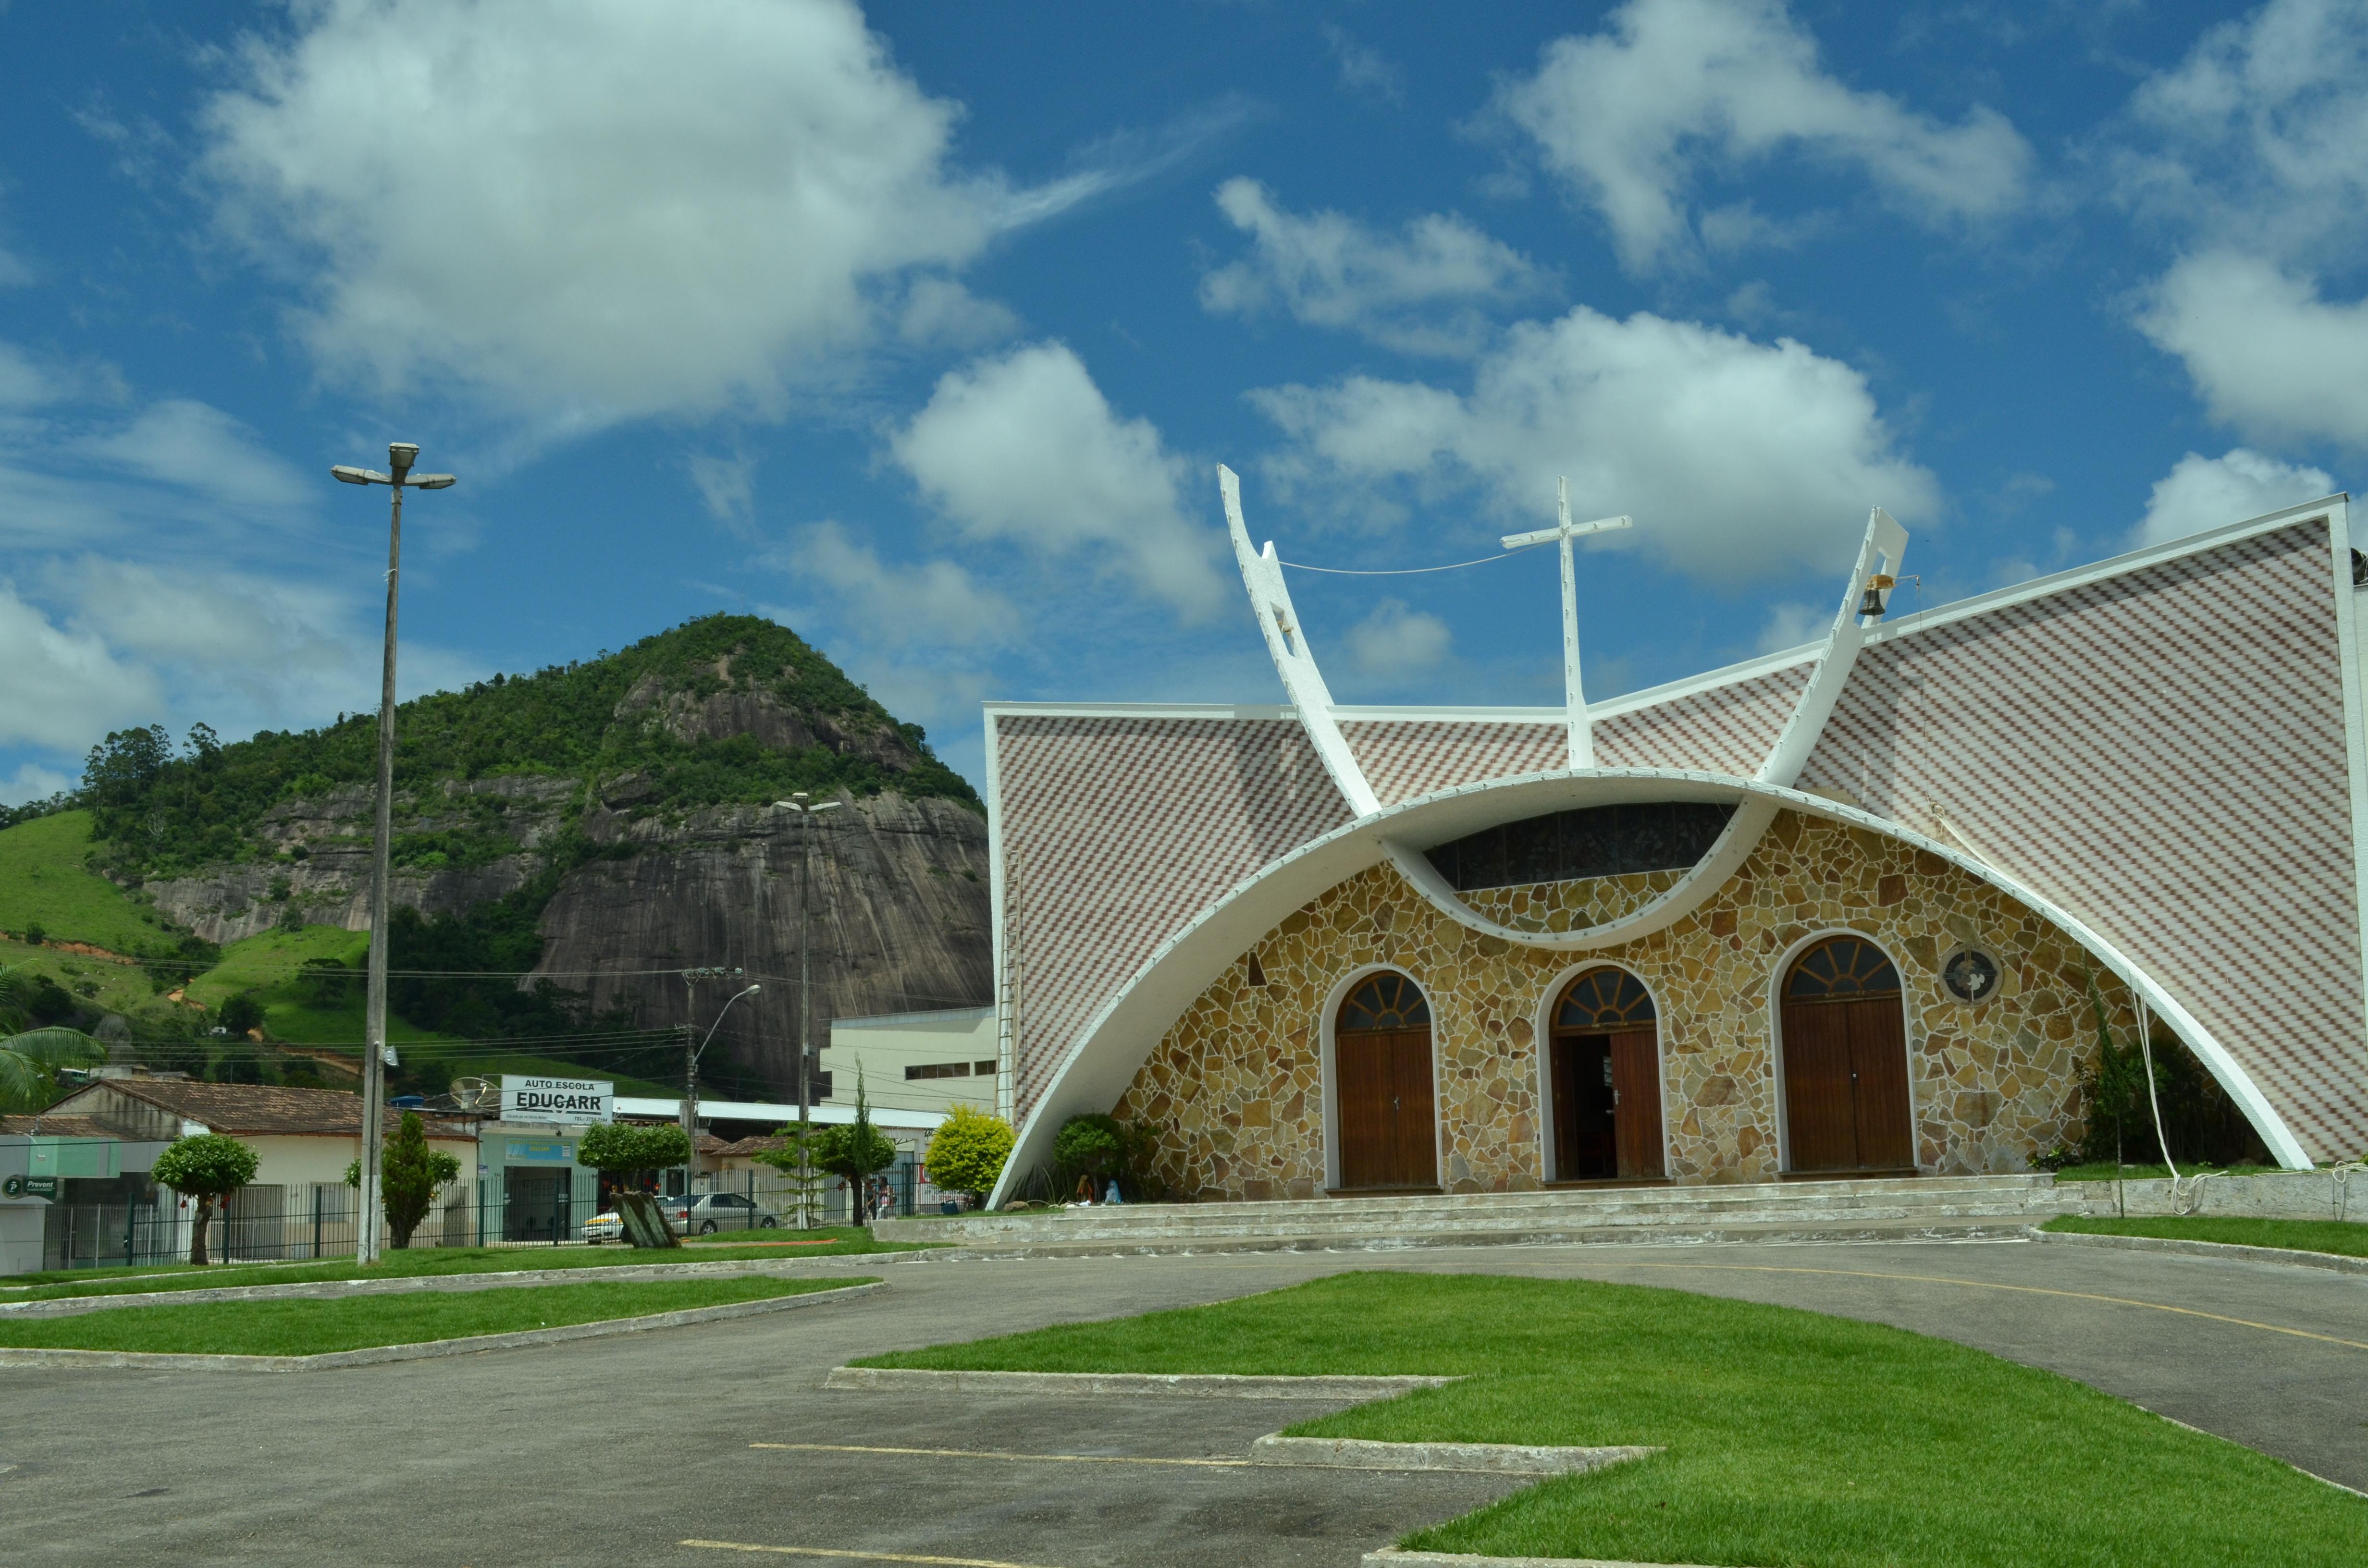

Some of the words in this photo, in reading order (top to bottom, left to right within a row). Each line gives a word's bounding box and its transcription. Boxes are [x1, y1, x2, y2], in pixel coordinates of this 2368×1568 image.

[525, 1079, 552, 1088] AUTO
[556, 1081, 594, 1090] ESCOLA
[517, 1092, 601, 1110] EDUCARR
